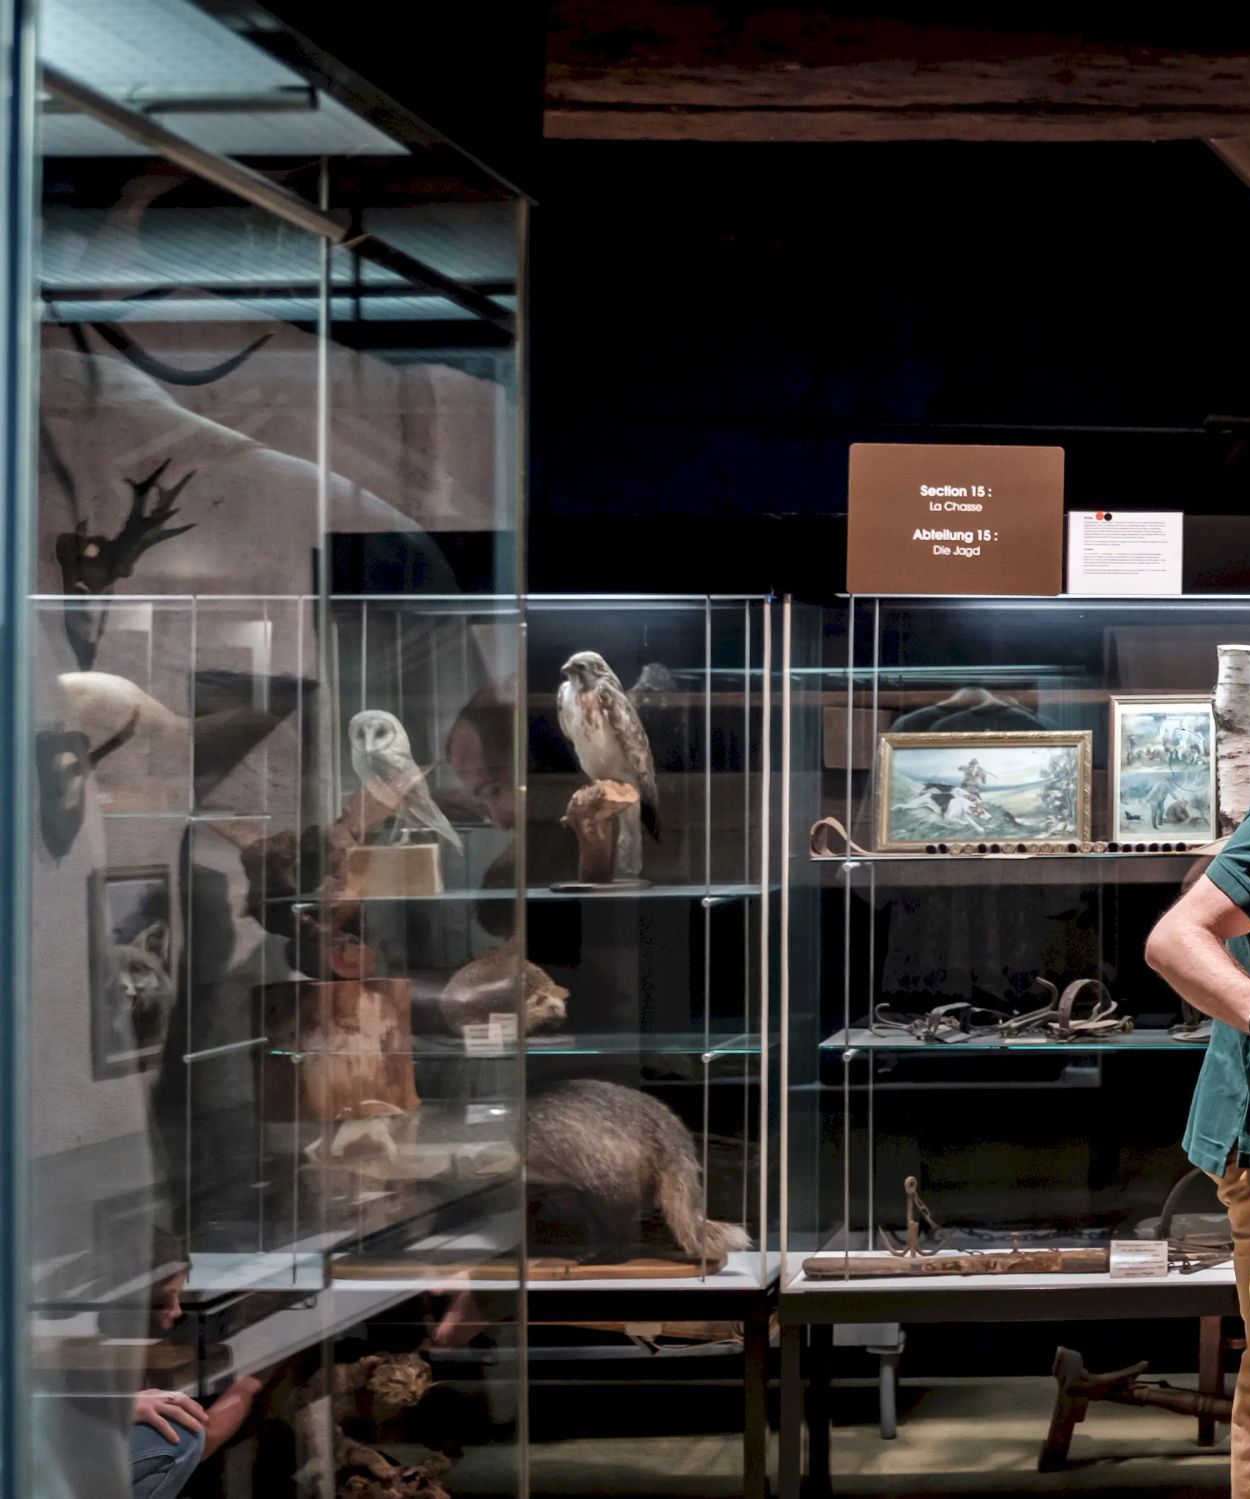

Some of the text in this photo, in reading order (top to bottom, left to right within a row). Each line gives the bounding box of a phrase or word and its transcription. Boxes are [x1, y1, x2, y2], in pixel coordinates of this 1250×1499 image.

[920, 485, 967, 497] Section
[971, 486, 985, 497] 15
[929, 501, 983, 512] La Chasse
[912, 528, 973, 543] Abteilung
[977, 529, 991, 541] 15
[933, 545, 981, 557] Die Jagd
